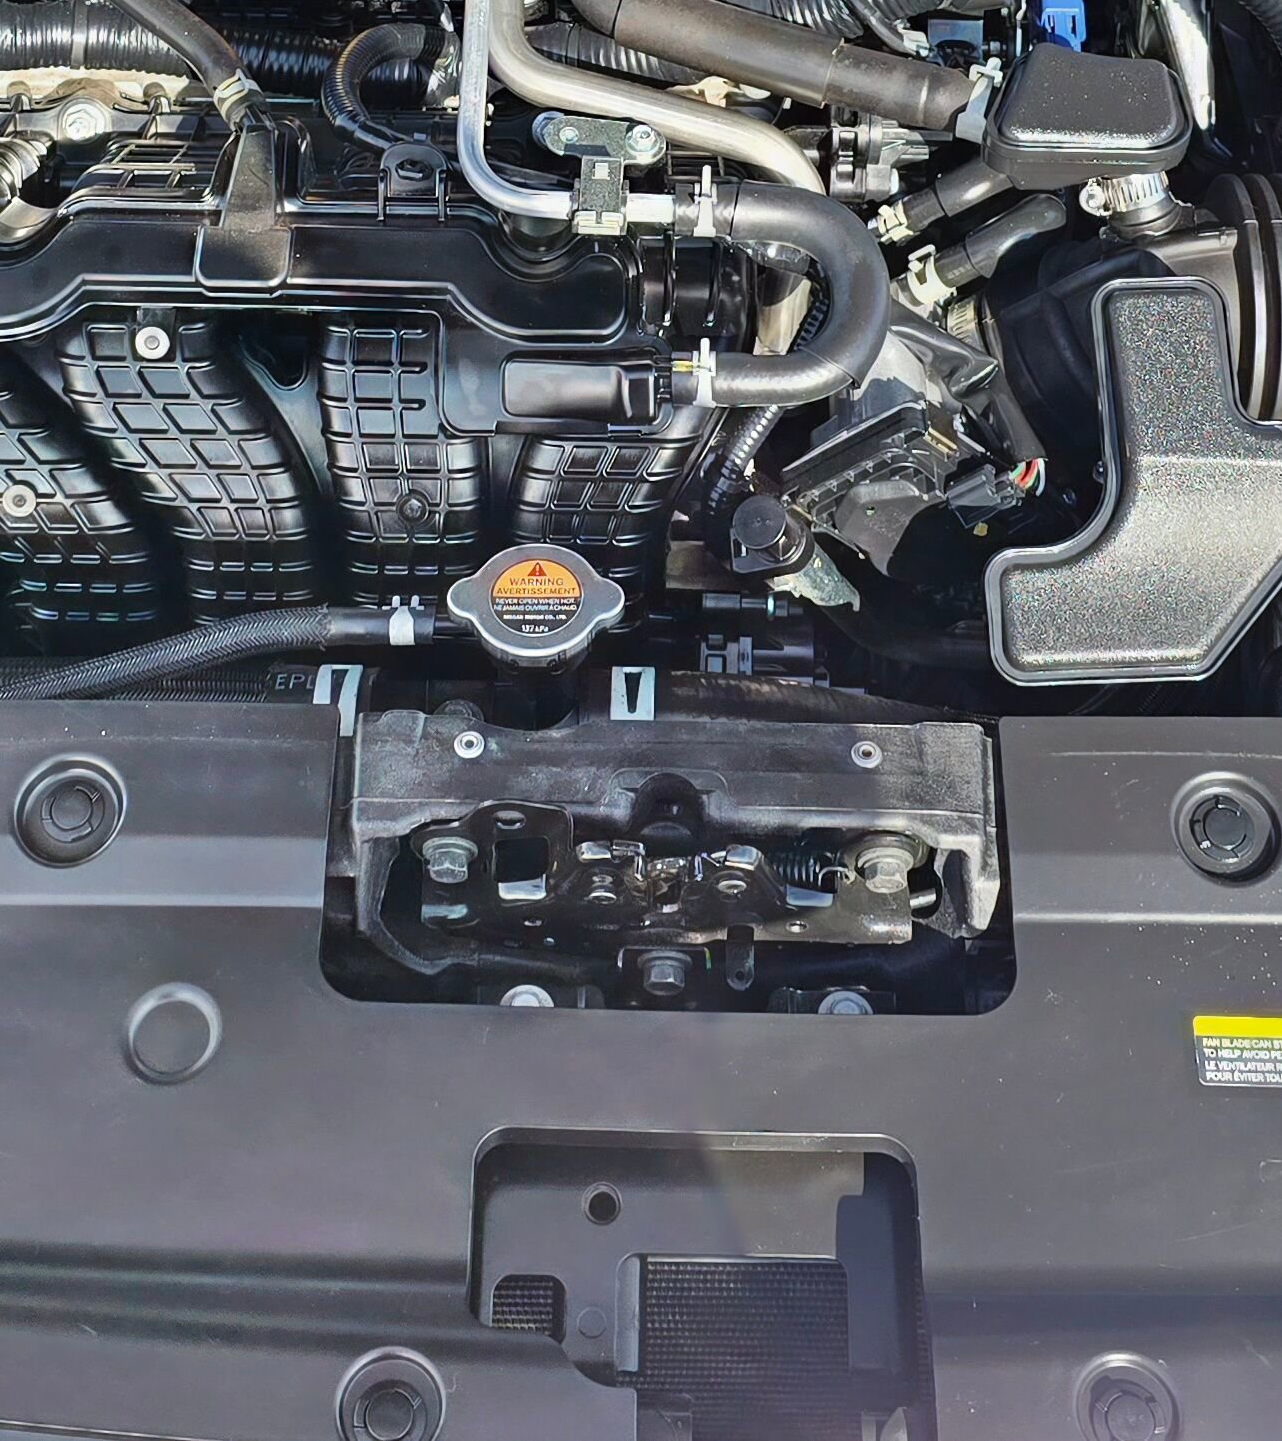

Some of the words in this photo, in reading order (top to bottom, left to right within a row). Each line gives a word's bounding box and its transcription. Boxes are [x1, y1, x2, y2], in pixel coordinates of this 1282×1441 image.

[510, 578, 564, 586] WARNING
[496, 587, 576, 595] AVERTISSEMENT
[1203, 1038, 1219, 1047] FAN
[1222, 1039, 1252, 1048] BLADE
[1253, 1039, 1271, 1049] CAN
[1203, 1048, 1216, 1058] TO
[1218, 1049, 1241, 1059] HELP
[1242, 1050, 1270, 1059] AVOID
[1205, 1060, 1216, 1070] LE
[1218, 1061, 1275, 1071] VENTILATEUR
[1207, 1072, 1232, 1081] POUR
[1234, 1071, 1264, 1082] ÉVITER
